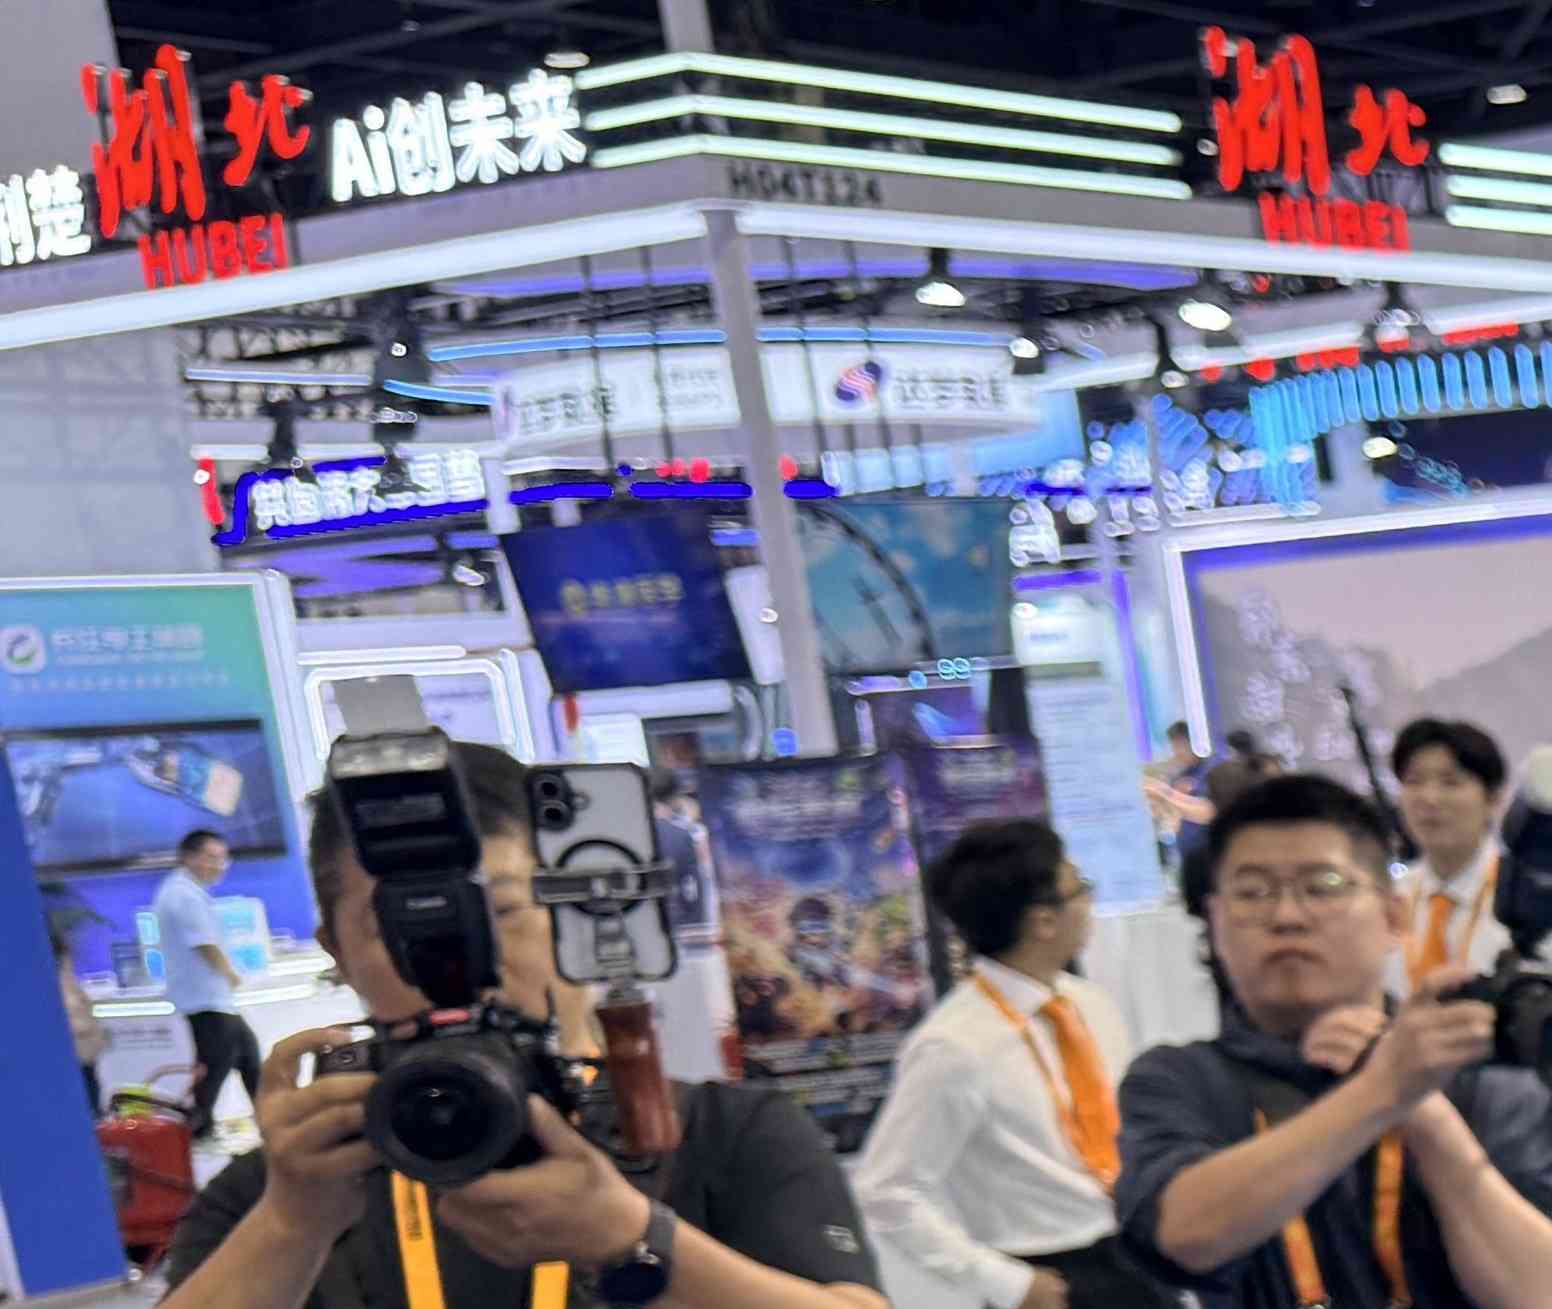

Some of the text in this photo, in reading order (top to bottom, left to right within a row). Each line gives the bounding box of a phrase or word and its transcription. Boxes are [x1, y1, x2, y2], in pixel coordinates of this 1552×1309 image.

[332, 68, 587, 203] Ai创未来
[138, 211, 289, 293] HUBEI
[1257, 191, 1412, 257] HUBEI
